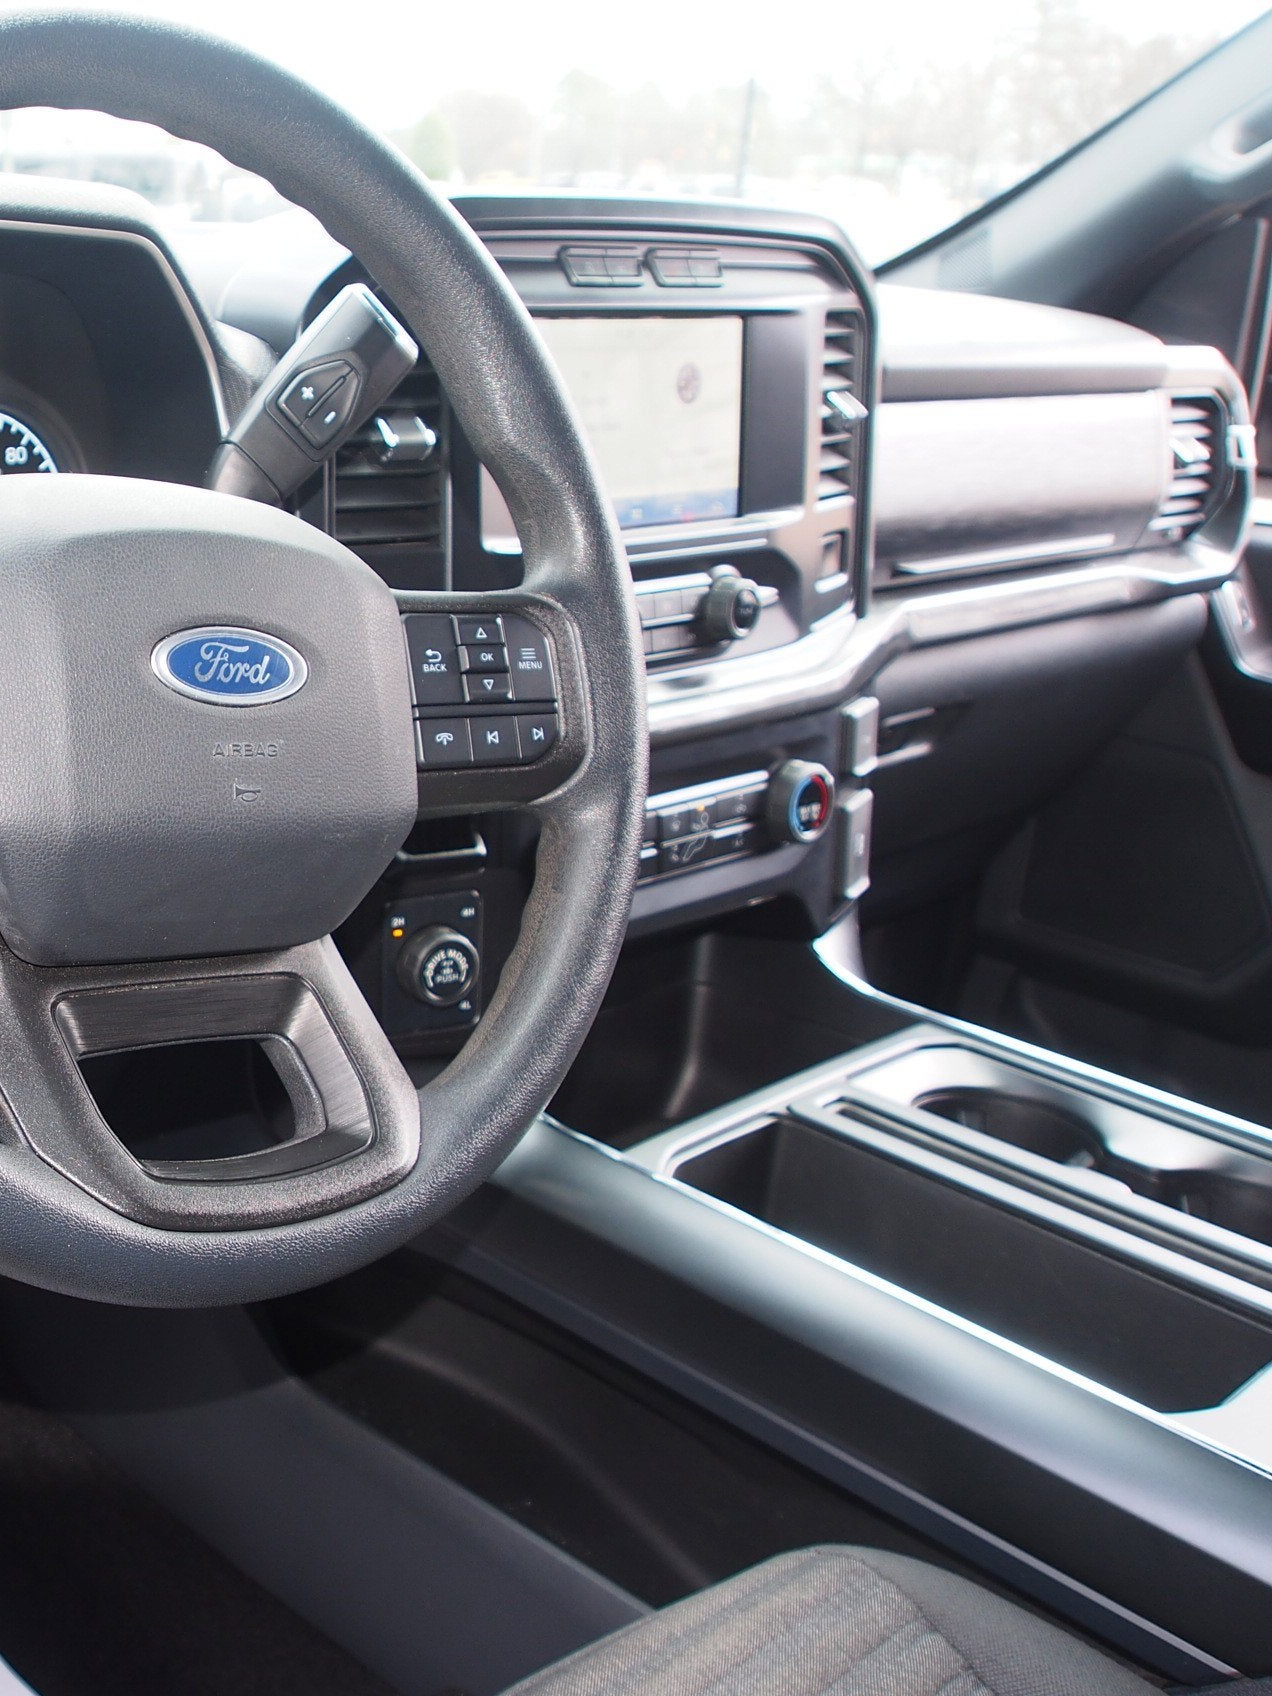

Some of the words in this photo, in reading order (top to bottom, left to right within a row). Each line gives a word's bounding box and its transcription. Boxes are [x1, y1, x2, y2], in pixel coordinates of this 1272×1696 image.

[4, 446, 28, 466] 80
[481, 652, 495, 662] OK
[194, 640, 272, 686] Ford
[423, 663, 447, 673] BACK
[519, 661, 543, 670] MENU
[212, 743, 278, 757] AIRBAG
[461, 908, 475, 917] 4H
[392, 917, 405, 927] 2H
[436, 974, 459, 983] PUSH
[460, 1002, 471, 1010] 4L
